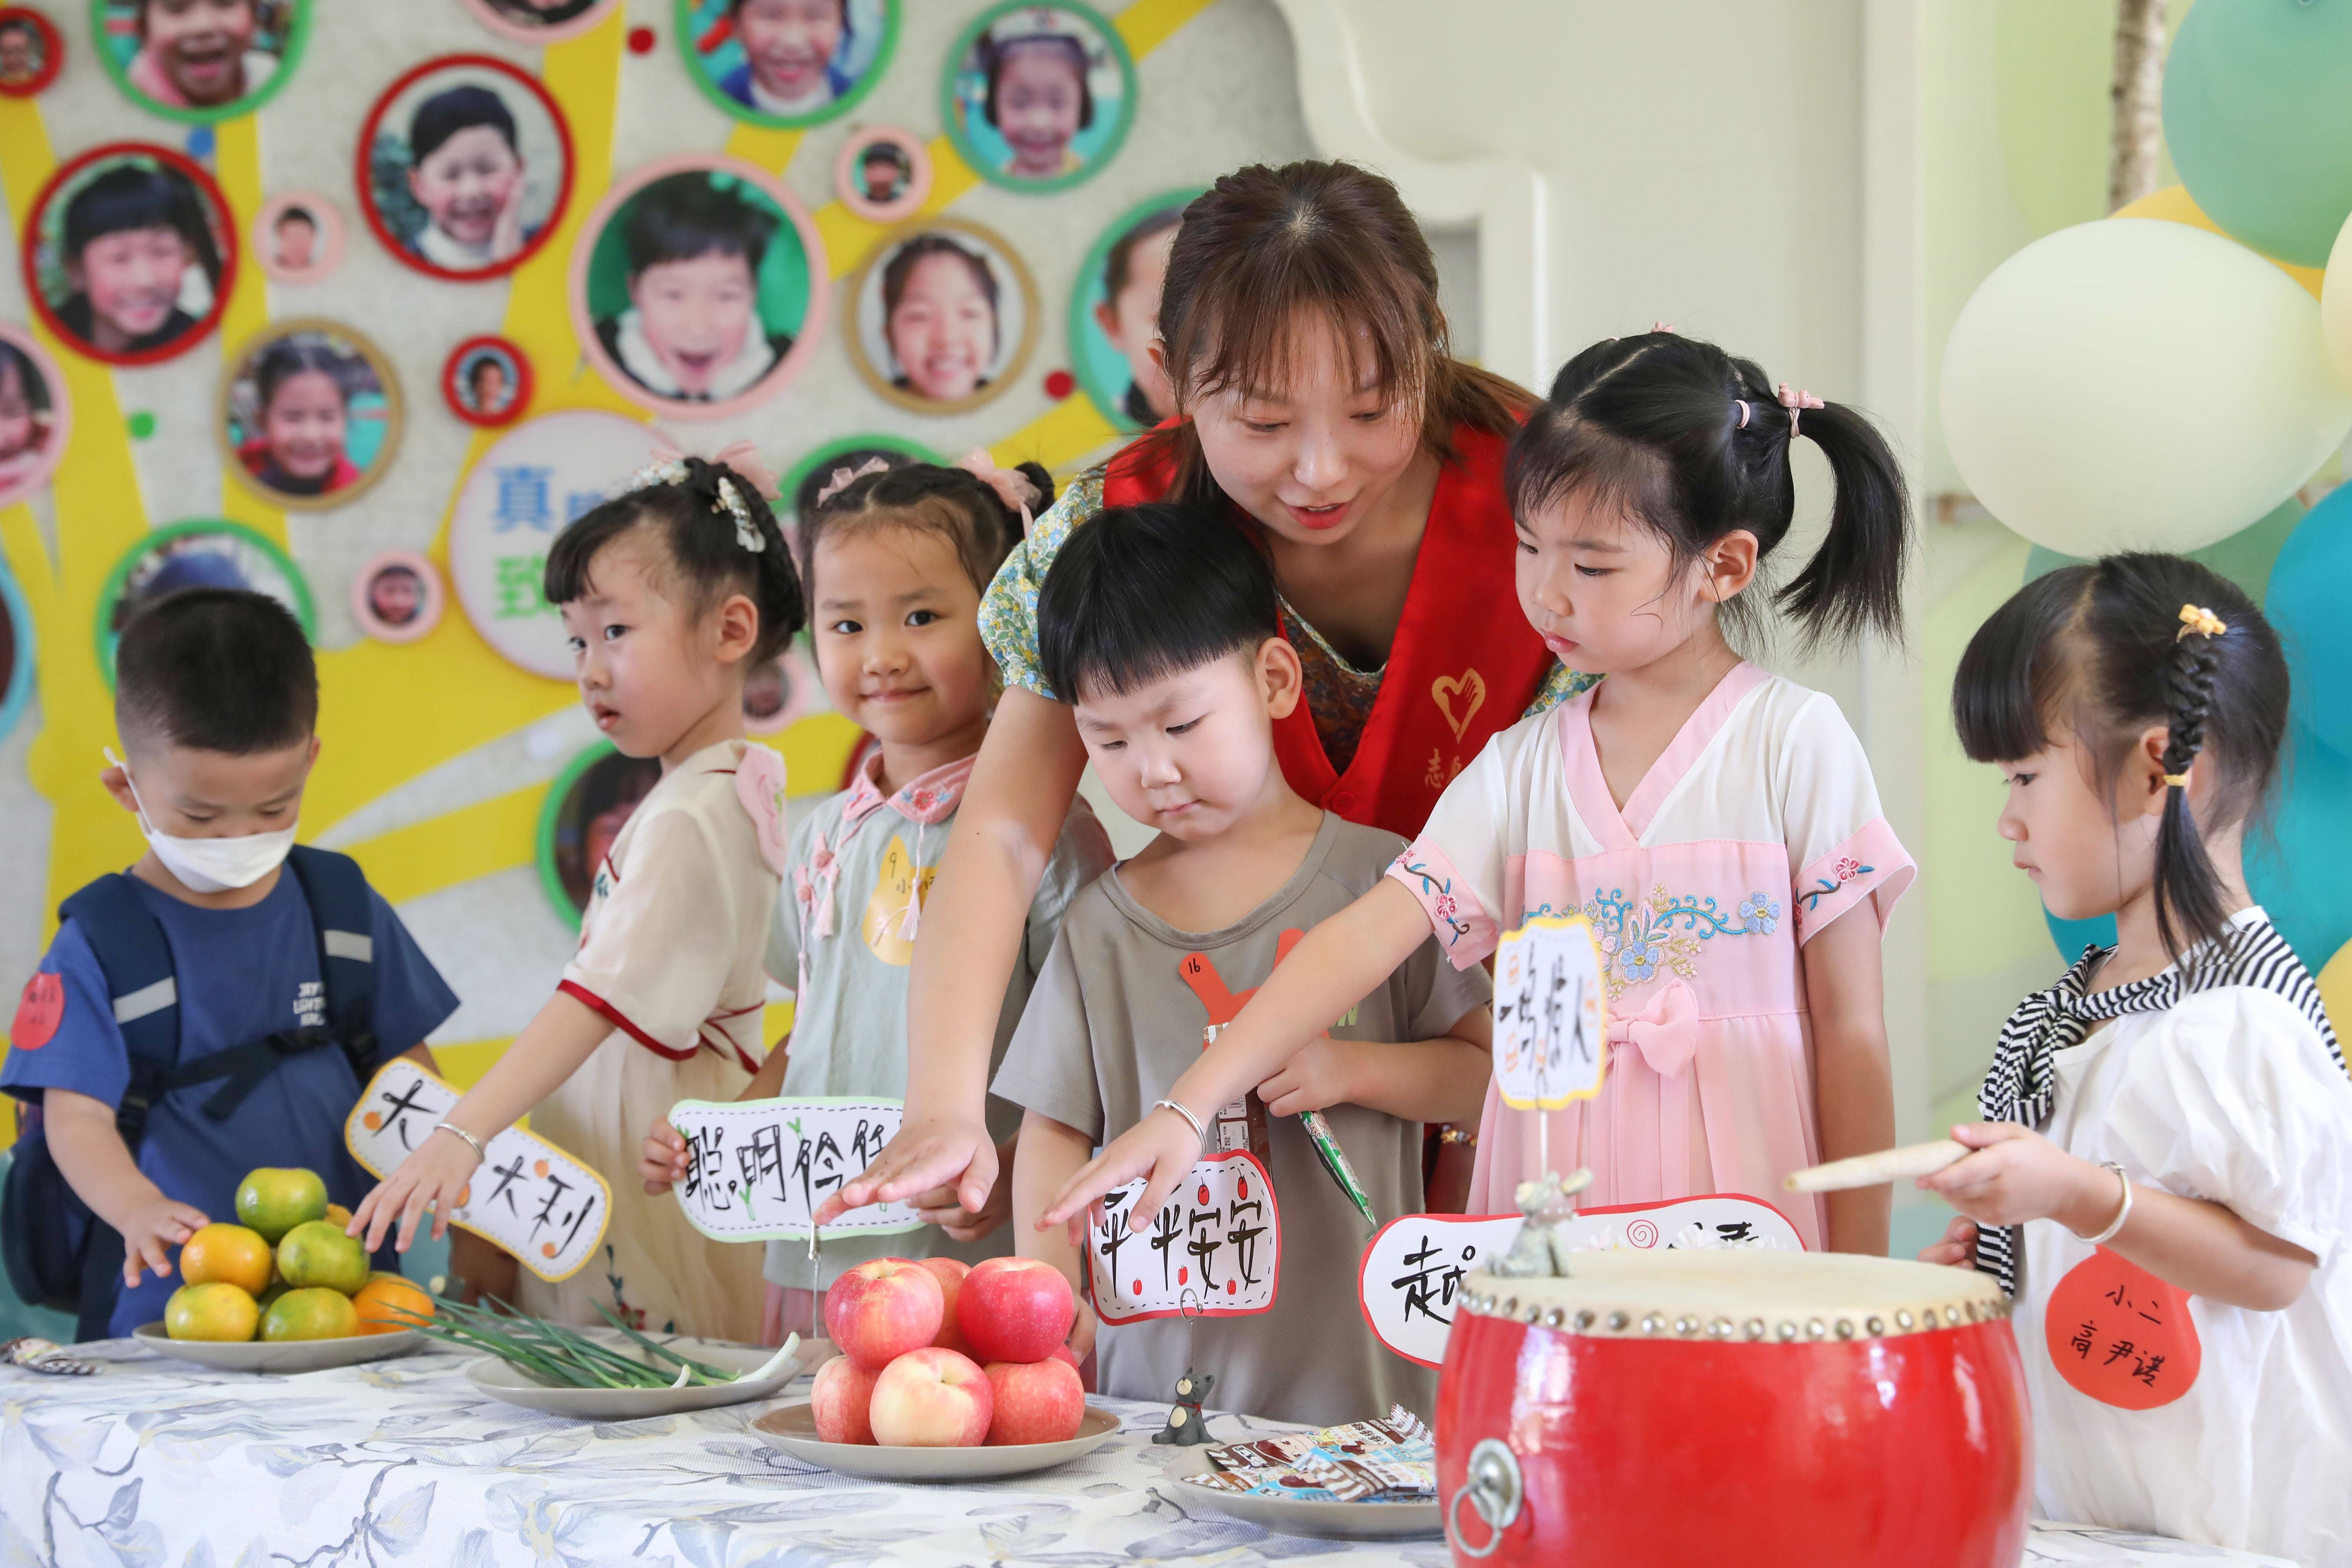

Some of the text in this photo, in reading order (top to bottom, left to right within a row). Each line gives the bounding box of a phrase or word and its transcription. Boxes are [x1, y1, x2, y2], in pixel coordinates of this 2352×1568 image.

[1189, 958, 1200, 974] 16
[372, 1079, 595, 1260] 大大利
[1101, 1183, 1268, 1299] 平平安安
